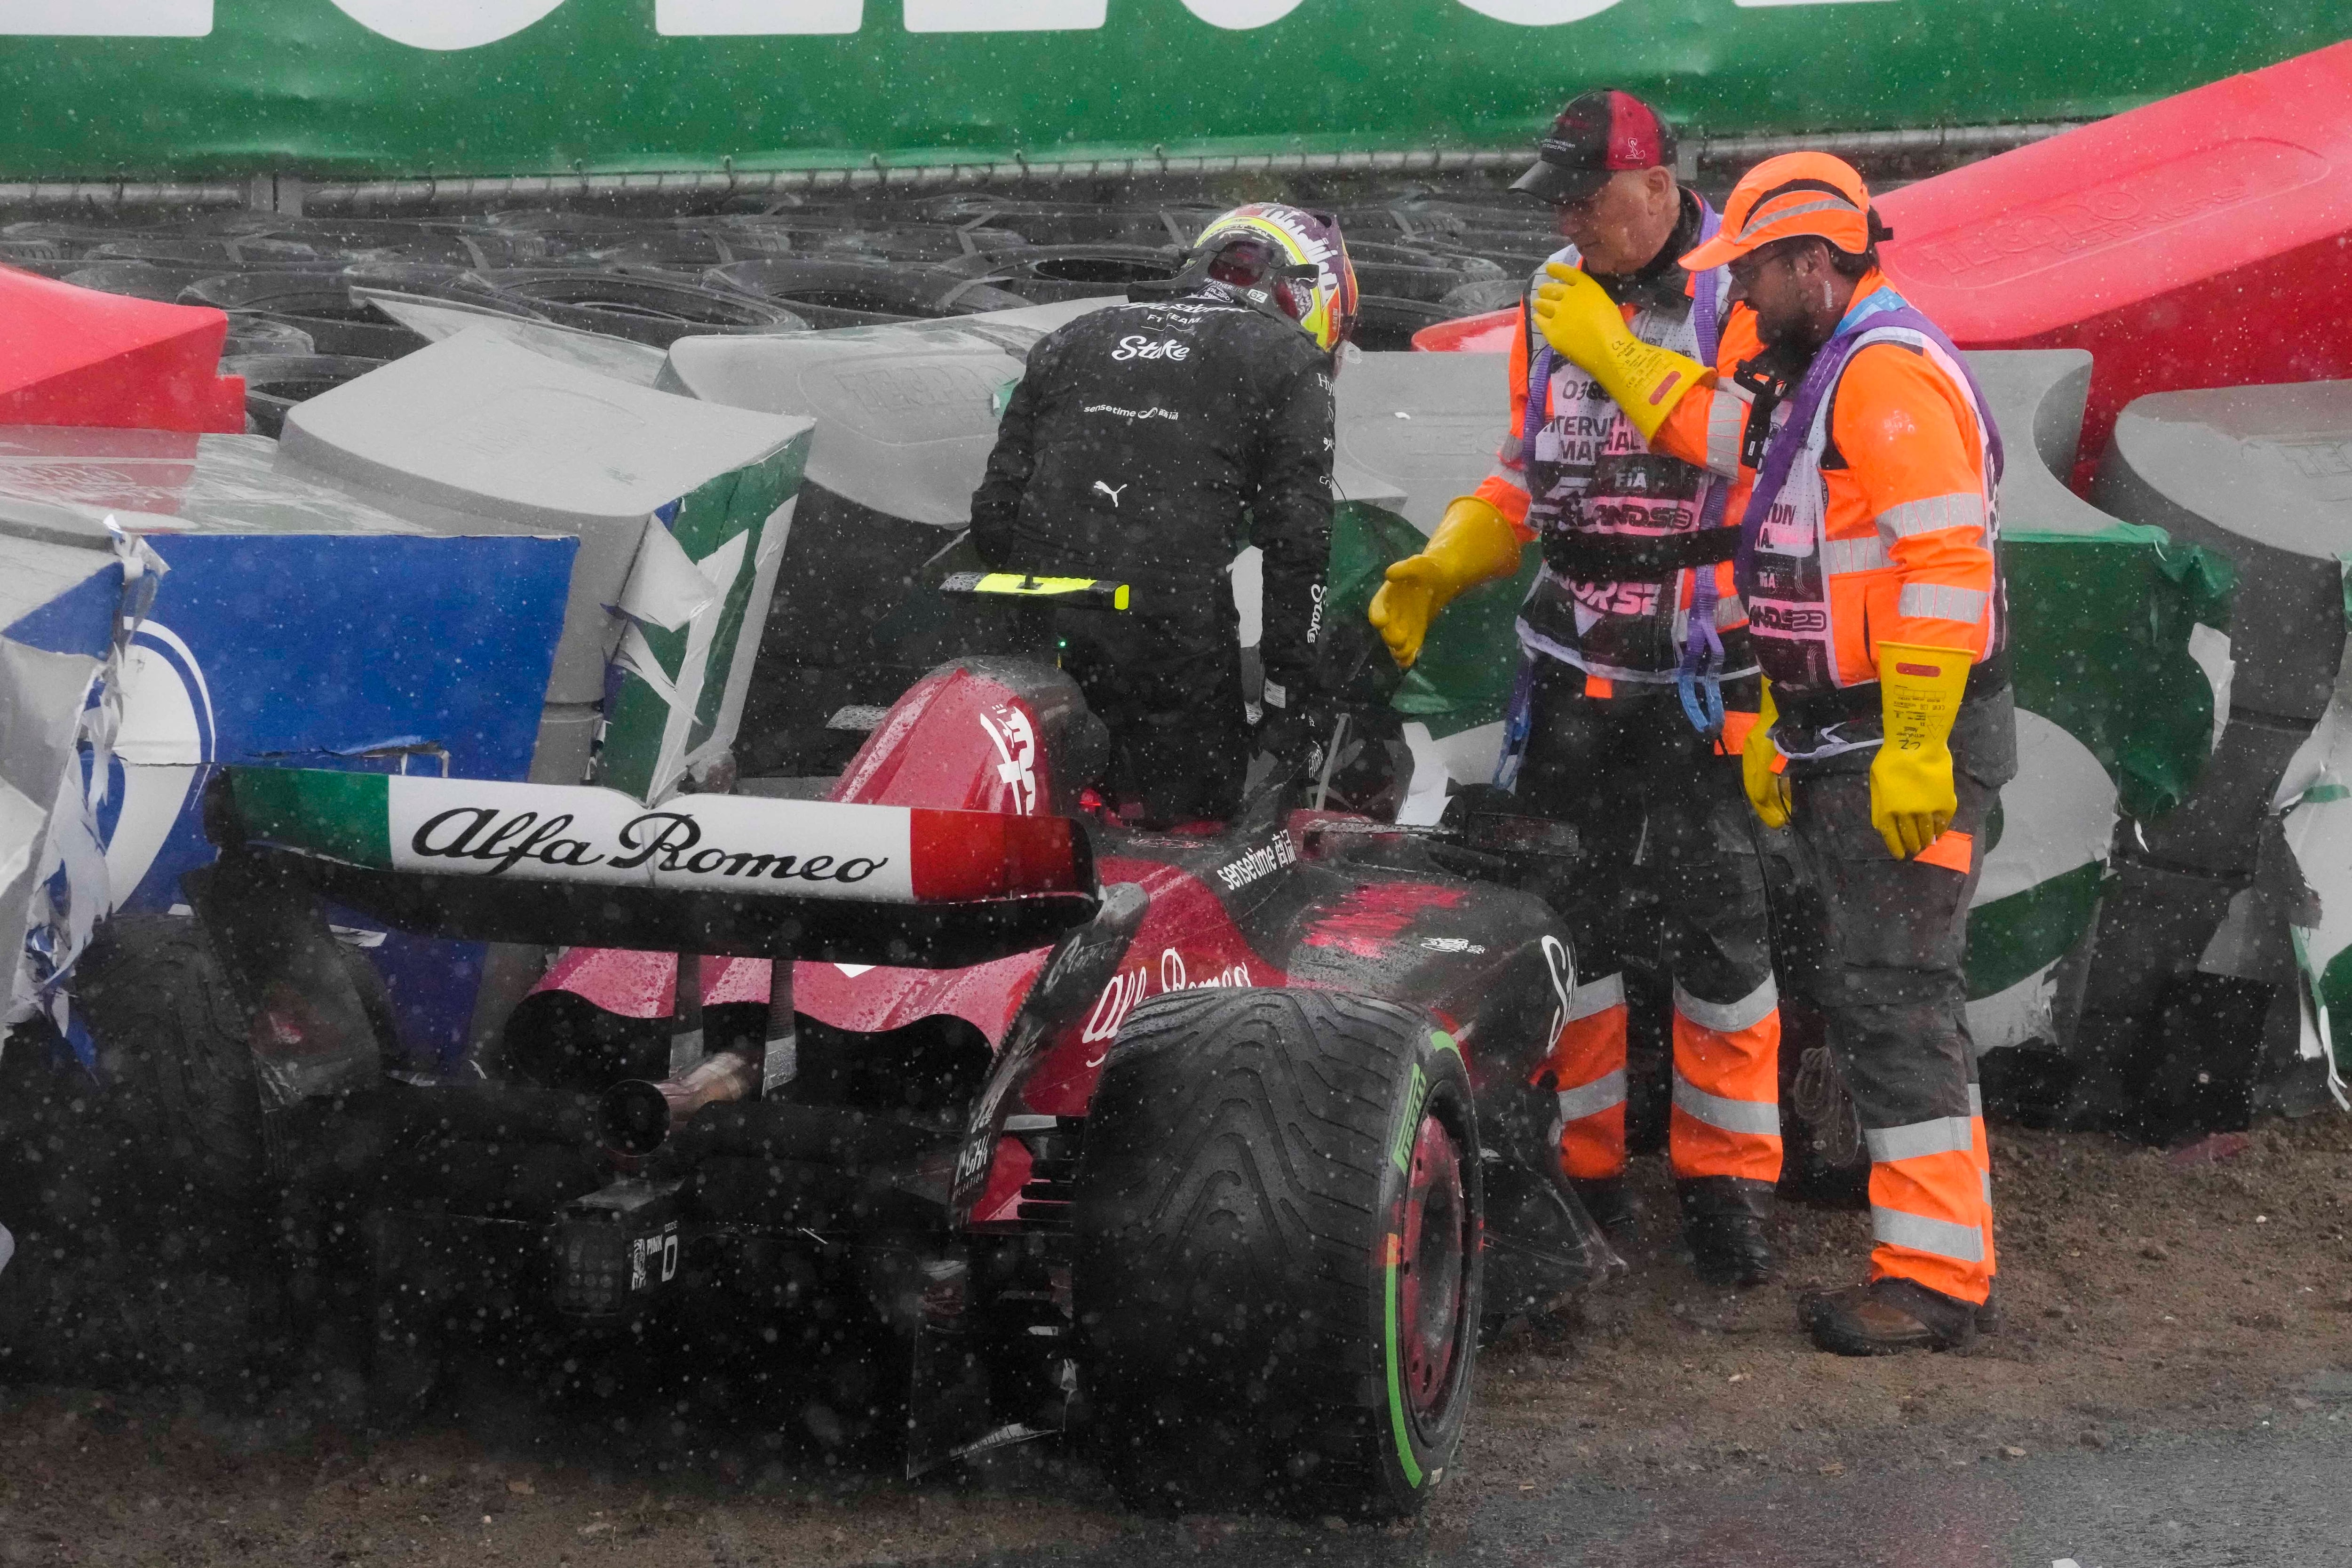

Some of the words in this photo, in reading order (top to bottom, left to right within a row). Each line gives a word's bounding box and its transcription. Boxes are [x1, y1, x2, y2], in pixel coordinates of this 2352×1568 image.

[1203, 277, 1245, 294] FEATHERLITE
[1249, 290, 1264, 301] GZ
[1147, 314, 1164, 322] F1
[1166, 312, 1201, 325] TEAM
[1112, 335, 1190, 361] Stake
[1083, 404, 1136, 417] sensetime
[1307, 583, 1328, 644] Stake
[412, 807, 604, 876] Alfa
[607, 812, 888, 883] Romeo
[1216, 845, 1277, 891] sensetime
